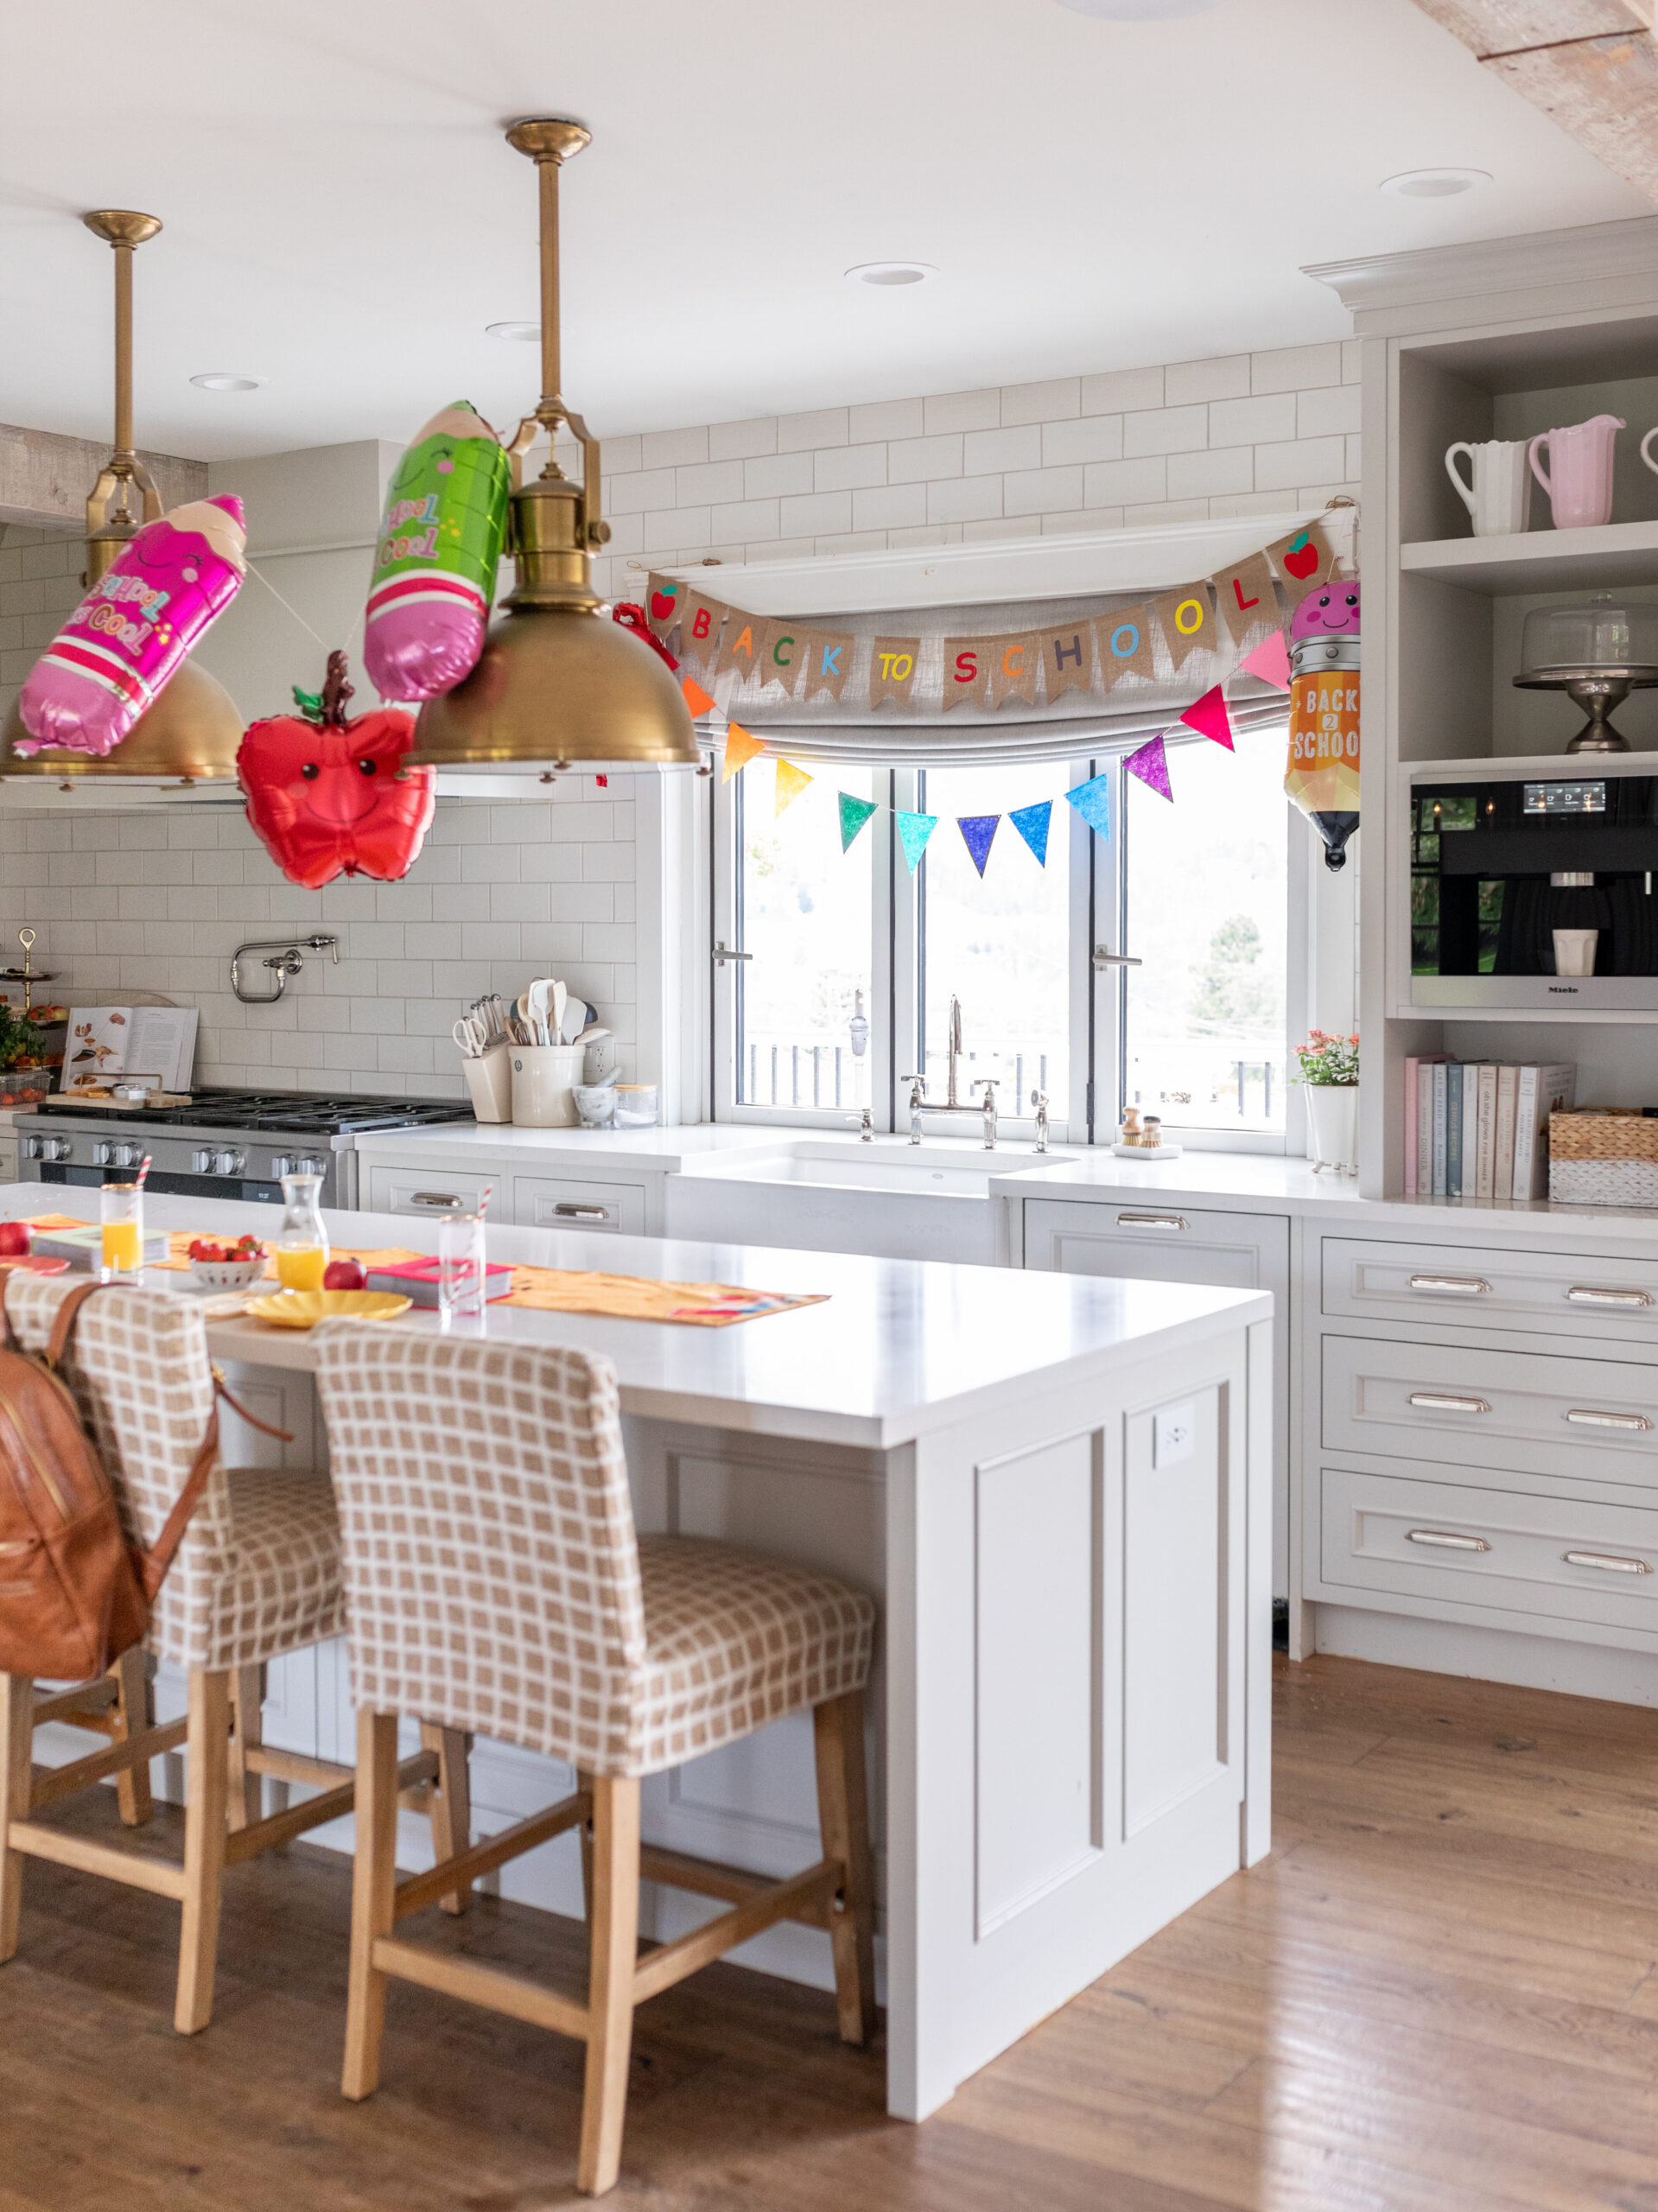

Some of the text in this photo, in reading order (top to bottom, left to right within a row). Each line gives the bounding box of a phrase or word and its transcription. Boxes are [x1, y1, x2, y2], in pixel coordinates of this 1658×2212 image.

[692, 579, 1259, 683] BACK TO SCHOOL
[1306, 689, 1358, 713] BACK
[1324, 715, 1335, 729] 2
[1294, 730, 1360, 759] SCHOO
[1483, 1091, 1491, 1102] oh
[1480, 1117, 1490, 1141] glows
